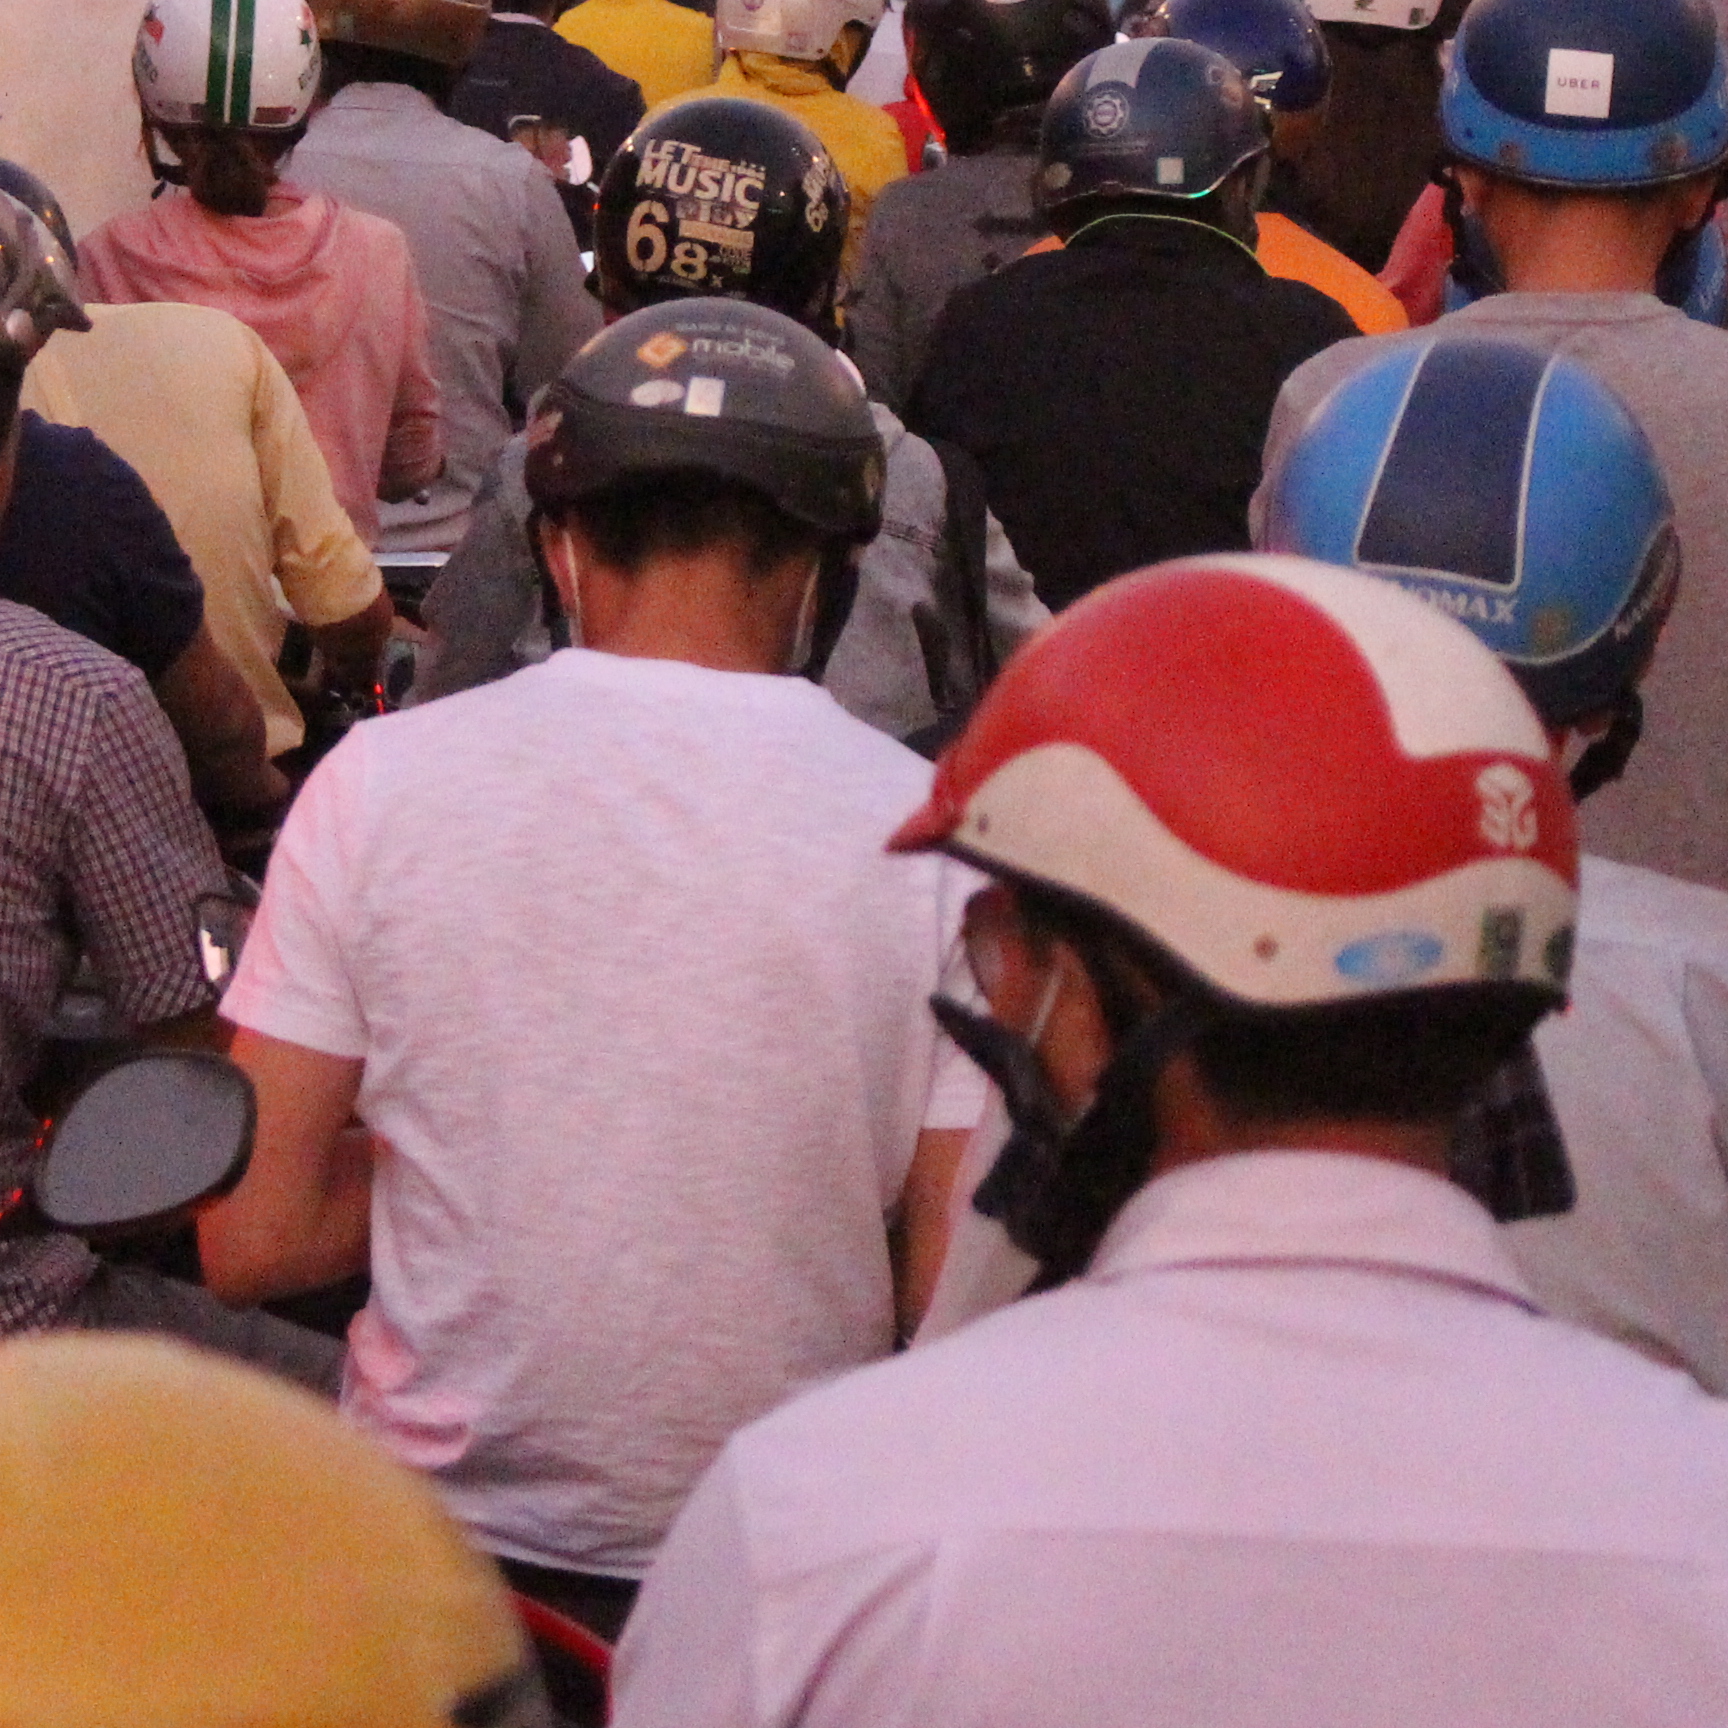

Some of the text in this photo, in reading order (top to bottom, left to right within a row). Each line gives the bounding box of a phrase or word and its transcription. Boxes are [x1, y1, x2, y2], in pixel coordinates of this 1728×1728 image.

[1557, 77, 1600, 90] UBER
[642, 139, 702, 165] LET
[636, 158, 765, 211] MUSIC
